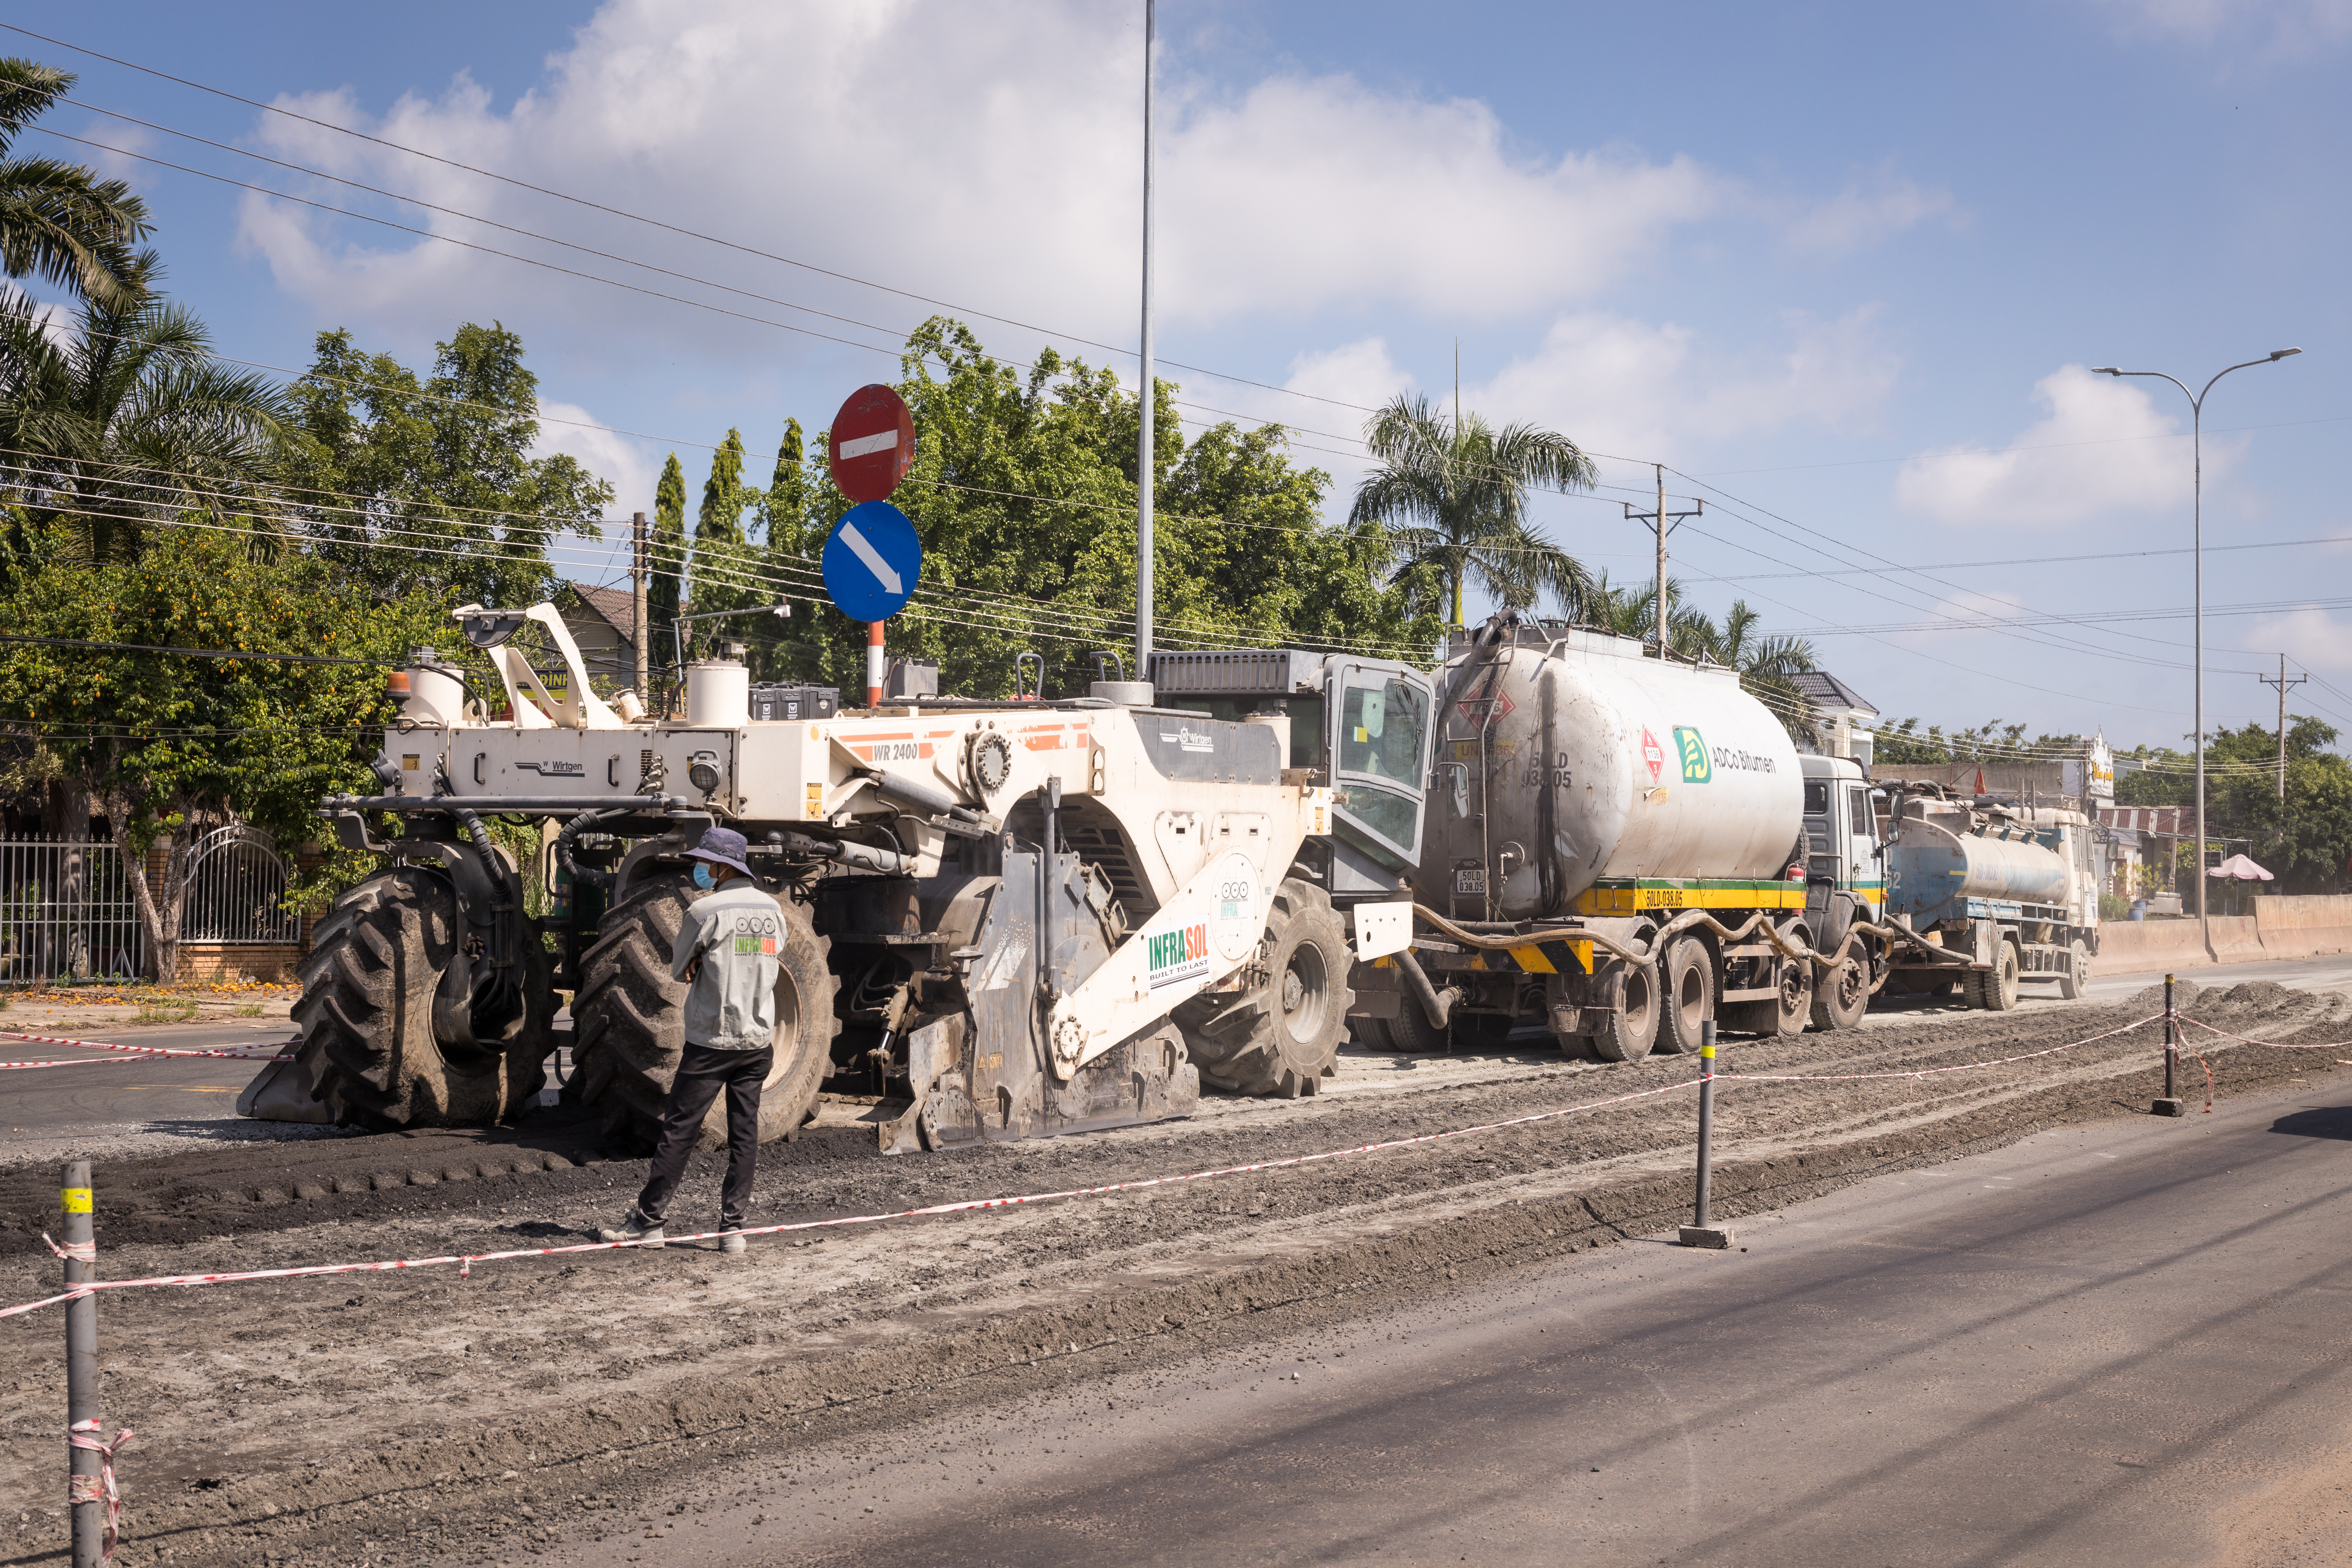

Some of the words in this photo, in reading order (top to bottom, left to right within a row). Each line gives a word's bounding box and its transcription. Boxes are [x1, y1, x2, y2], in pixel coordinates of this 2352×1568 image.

[1474, 703, 1501, 712] 16
[1189, 733, 1211, 747] Wirtgen
[874, 745, 890, 761] WR
[893, 743, 917, 760] 2400
[1648, 749, 1659, 759] 1136
[553, 761, 582, 772] Wirtgen
[1712, 747, 1739, 769] ADCo
[1738, 749, 1776, 774] Bitumen
[1654, 764, 1657, 774] 3
[1463, 871, 1480, 880] 50LD
[1460, 882, 1483, 891] 038.05
[735, 938, 776, 954] INFRASOL
[1149, 923, 1208, 971] INFRASOL
[1150, 969, 1174, 980] BUILT
[1190, 960, 1208, 969] LAST
